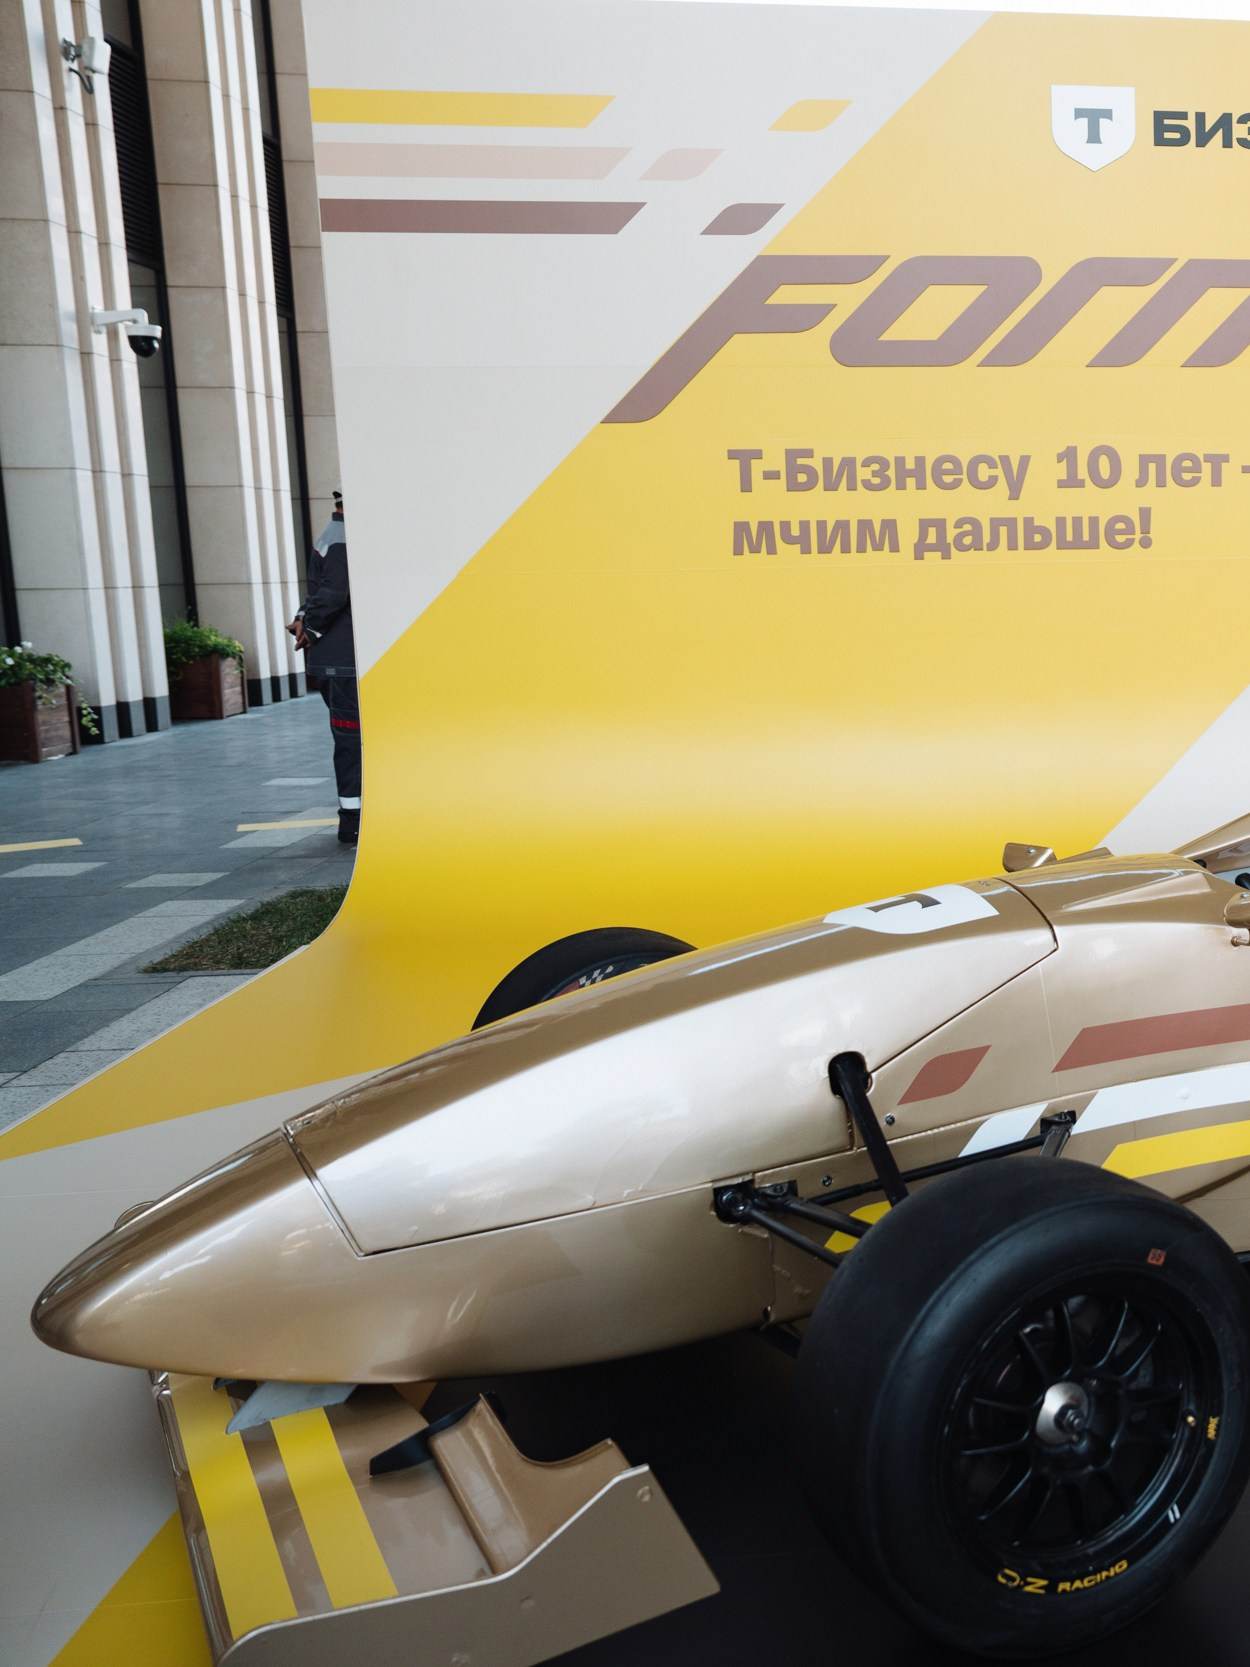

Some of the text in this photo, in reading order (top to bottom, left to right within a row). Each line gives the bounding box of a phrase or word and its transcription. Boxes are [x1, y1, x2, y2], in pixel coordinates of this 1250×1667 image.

[727, 447, 1031, 500] Т-Бизнесу
[1055, 444, 1122, 490] 10
[1135, 451, 1230, 489] лет
[732, 507, 1153, 560] мчим дальше!
[1057, 1559, 1128, 1594] RACING
